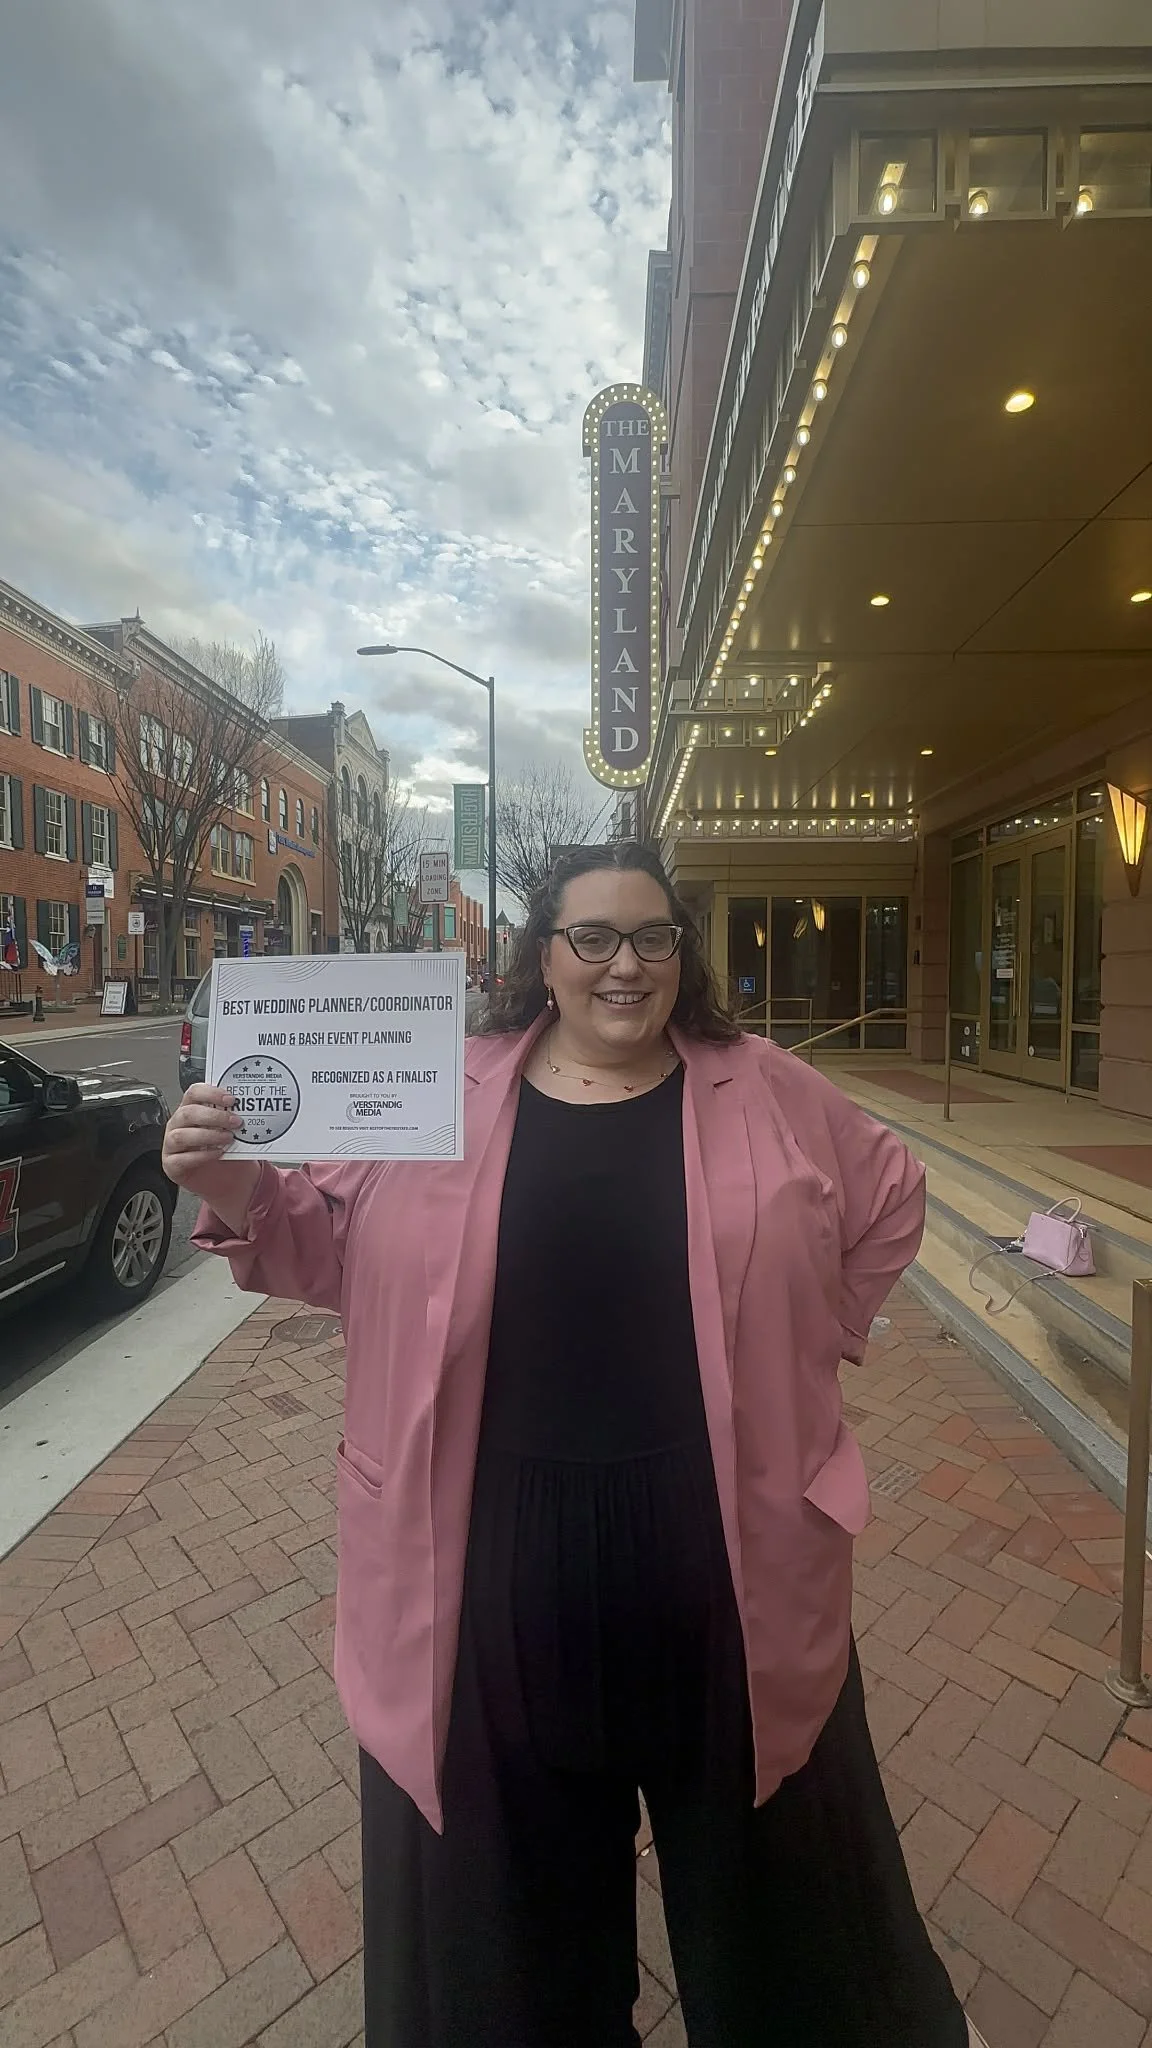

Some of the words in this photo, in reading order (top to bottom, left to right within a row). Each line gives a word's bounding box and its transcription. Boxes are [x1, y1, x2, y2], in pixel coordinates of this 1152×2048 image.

[602, 420, 649, 436] THE
[609, 447, 640, 752] MARYLAND
[460, 789, 478, 865] HAGERSTOWN
[422, 860, 430, 868] 15
[433, 859, 446, 867] MIN
[421, 873, 447, 881] LOADING
[427, 887, 442, 895] ZONE
[222, 1000, 250, 1015] BEST
[253, 998, 305, 1014] WEDDING
[308, 995, 453, 1013] PLANNER/COORDINATOR
[258, 1033, 286, 1046] WAND
[289, 1032, 296, 1045] &
[298, 1032, 325, 1045] BASH
[327, 1031, 359, 1045] EVENT
[361, 1030, 412, 1044] PLANNING
[311, 1070, 370, 1084] RECOGNIZED
[372, 1070, 385, 1083] AS
[387, 1070, 394, 1083] A
[396, 1070, 438, 1083] FINALIST
[226, 1086, 250, 1096] BEST
[253, 1086, 266, 1096] OF
[269, 1086, 287, 1096] THE
[224, 1098, 292, 1112] RISTATE
[353, 1100, 403, 1109] VERSTANDIG
[355, 1108, 382, 1117] MEDIA
[247, 1118, 266, 1126] 2026
